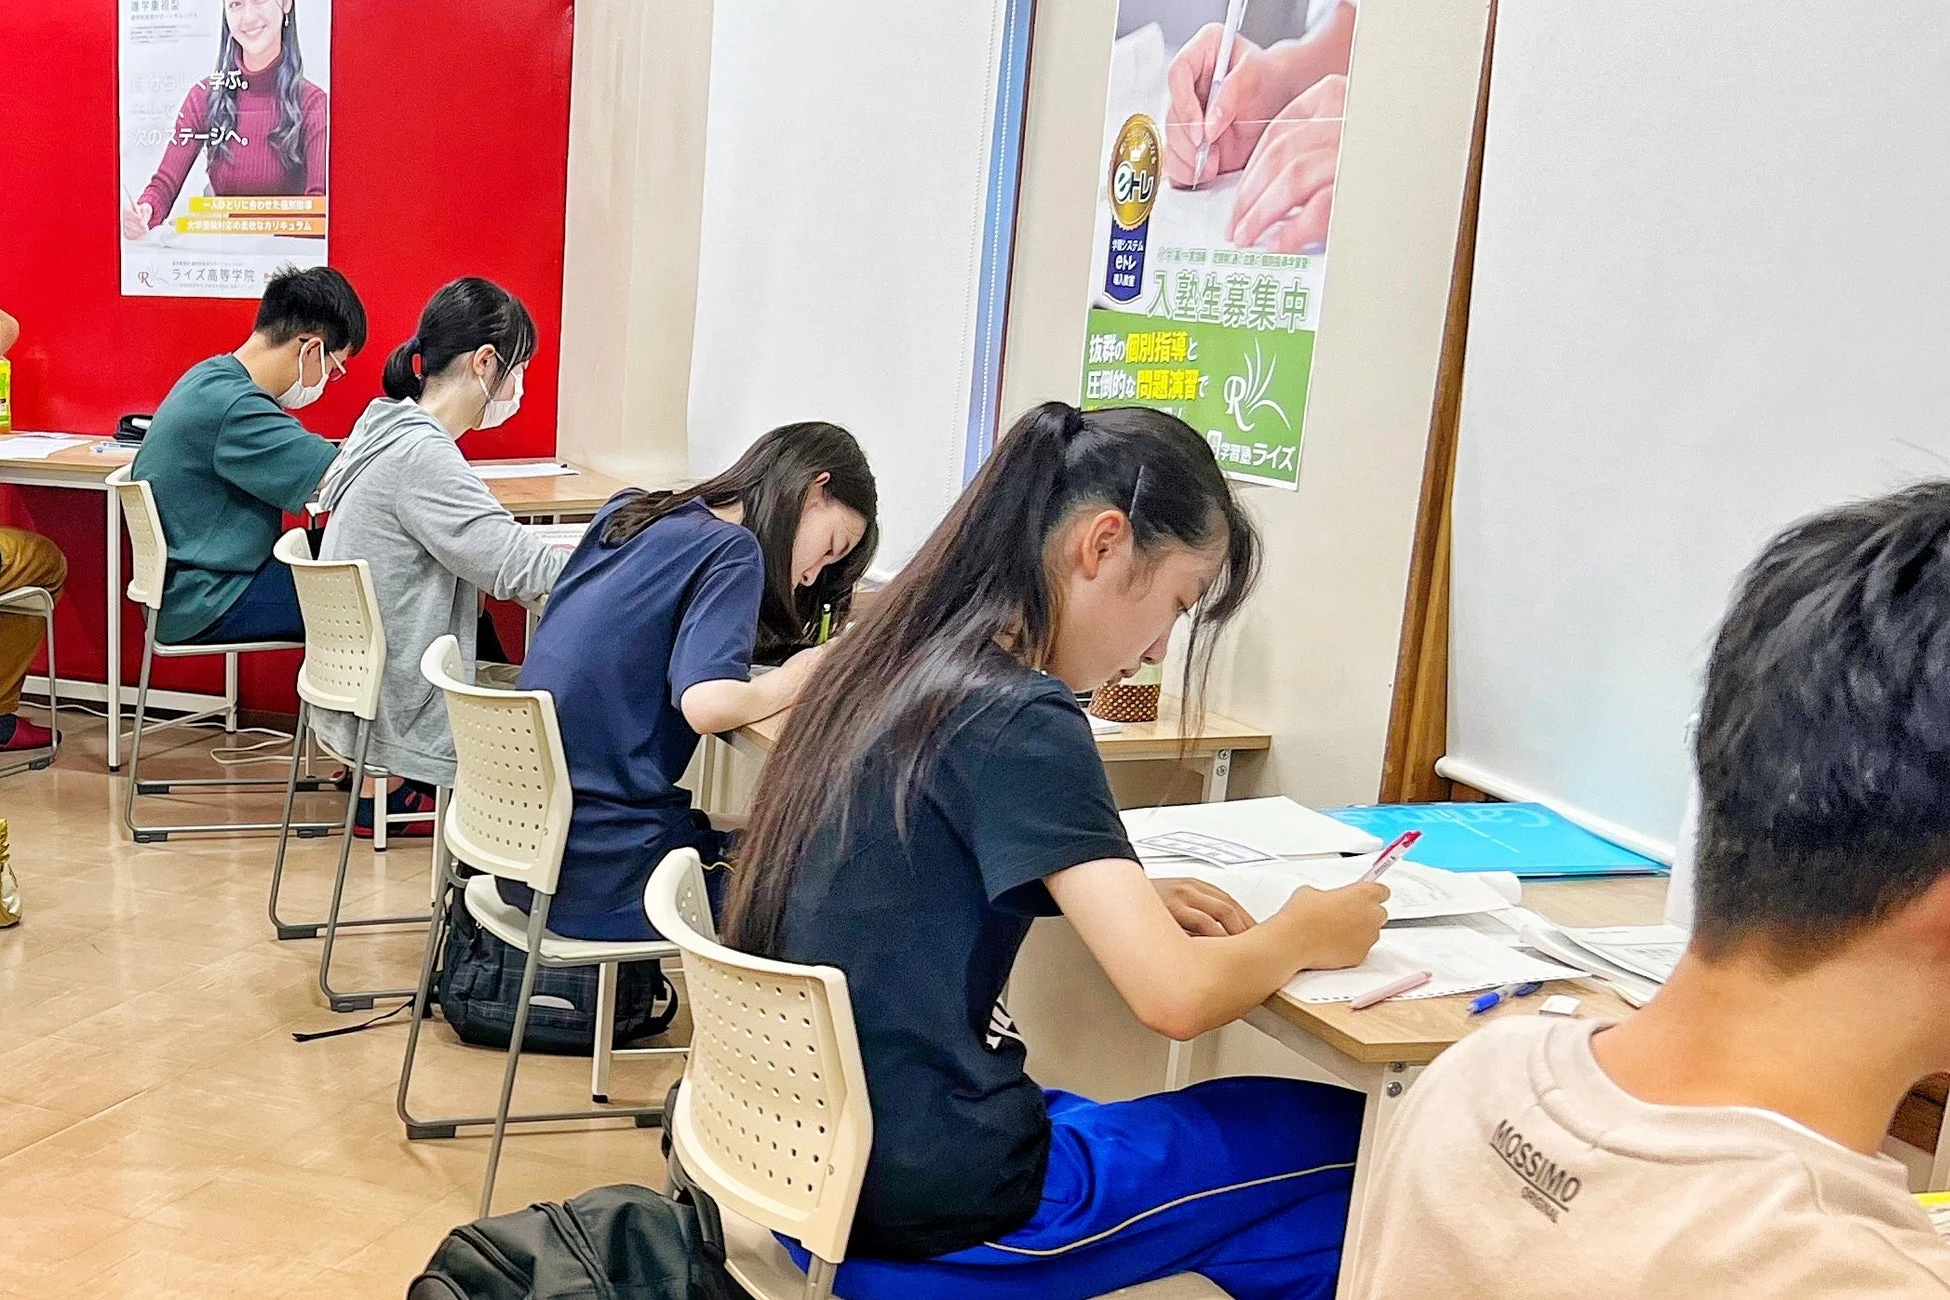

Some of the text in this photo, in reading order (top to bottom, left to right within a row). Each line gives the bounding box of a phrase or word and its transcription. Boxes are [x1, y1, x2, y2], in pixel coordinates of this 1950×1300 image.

[172, 268, 255, 283] ライズ高等学院
[1115, 254, 1138, 271] eトレ
[1148, 270, 1309, 333] 入塾生募集中
[1088, 331, 1198, 365] 抜群の個別指導と
[1086, 369, 1209, 400] 圧倒的な問題演習で
[1491, 1118, 1582, 1203] MOSSIMO
